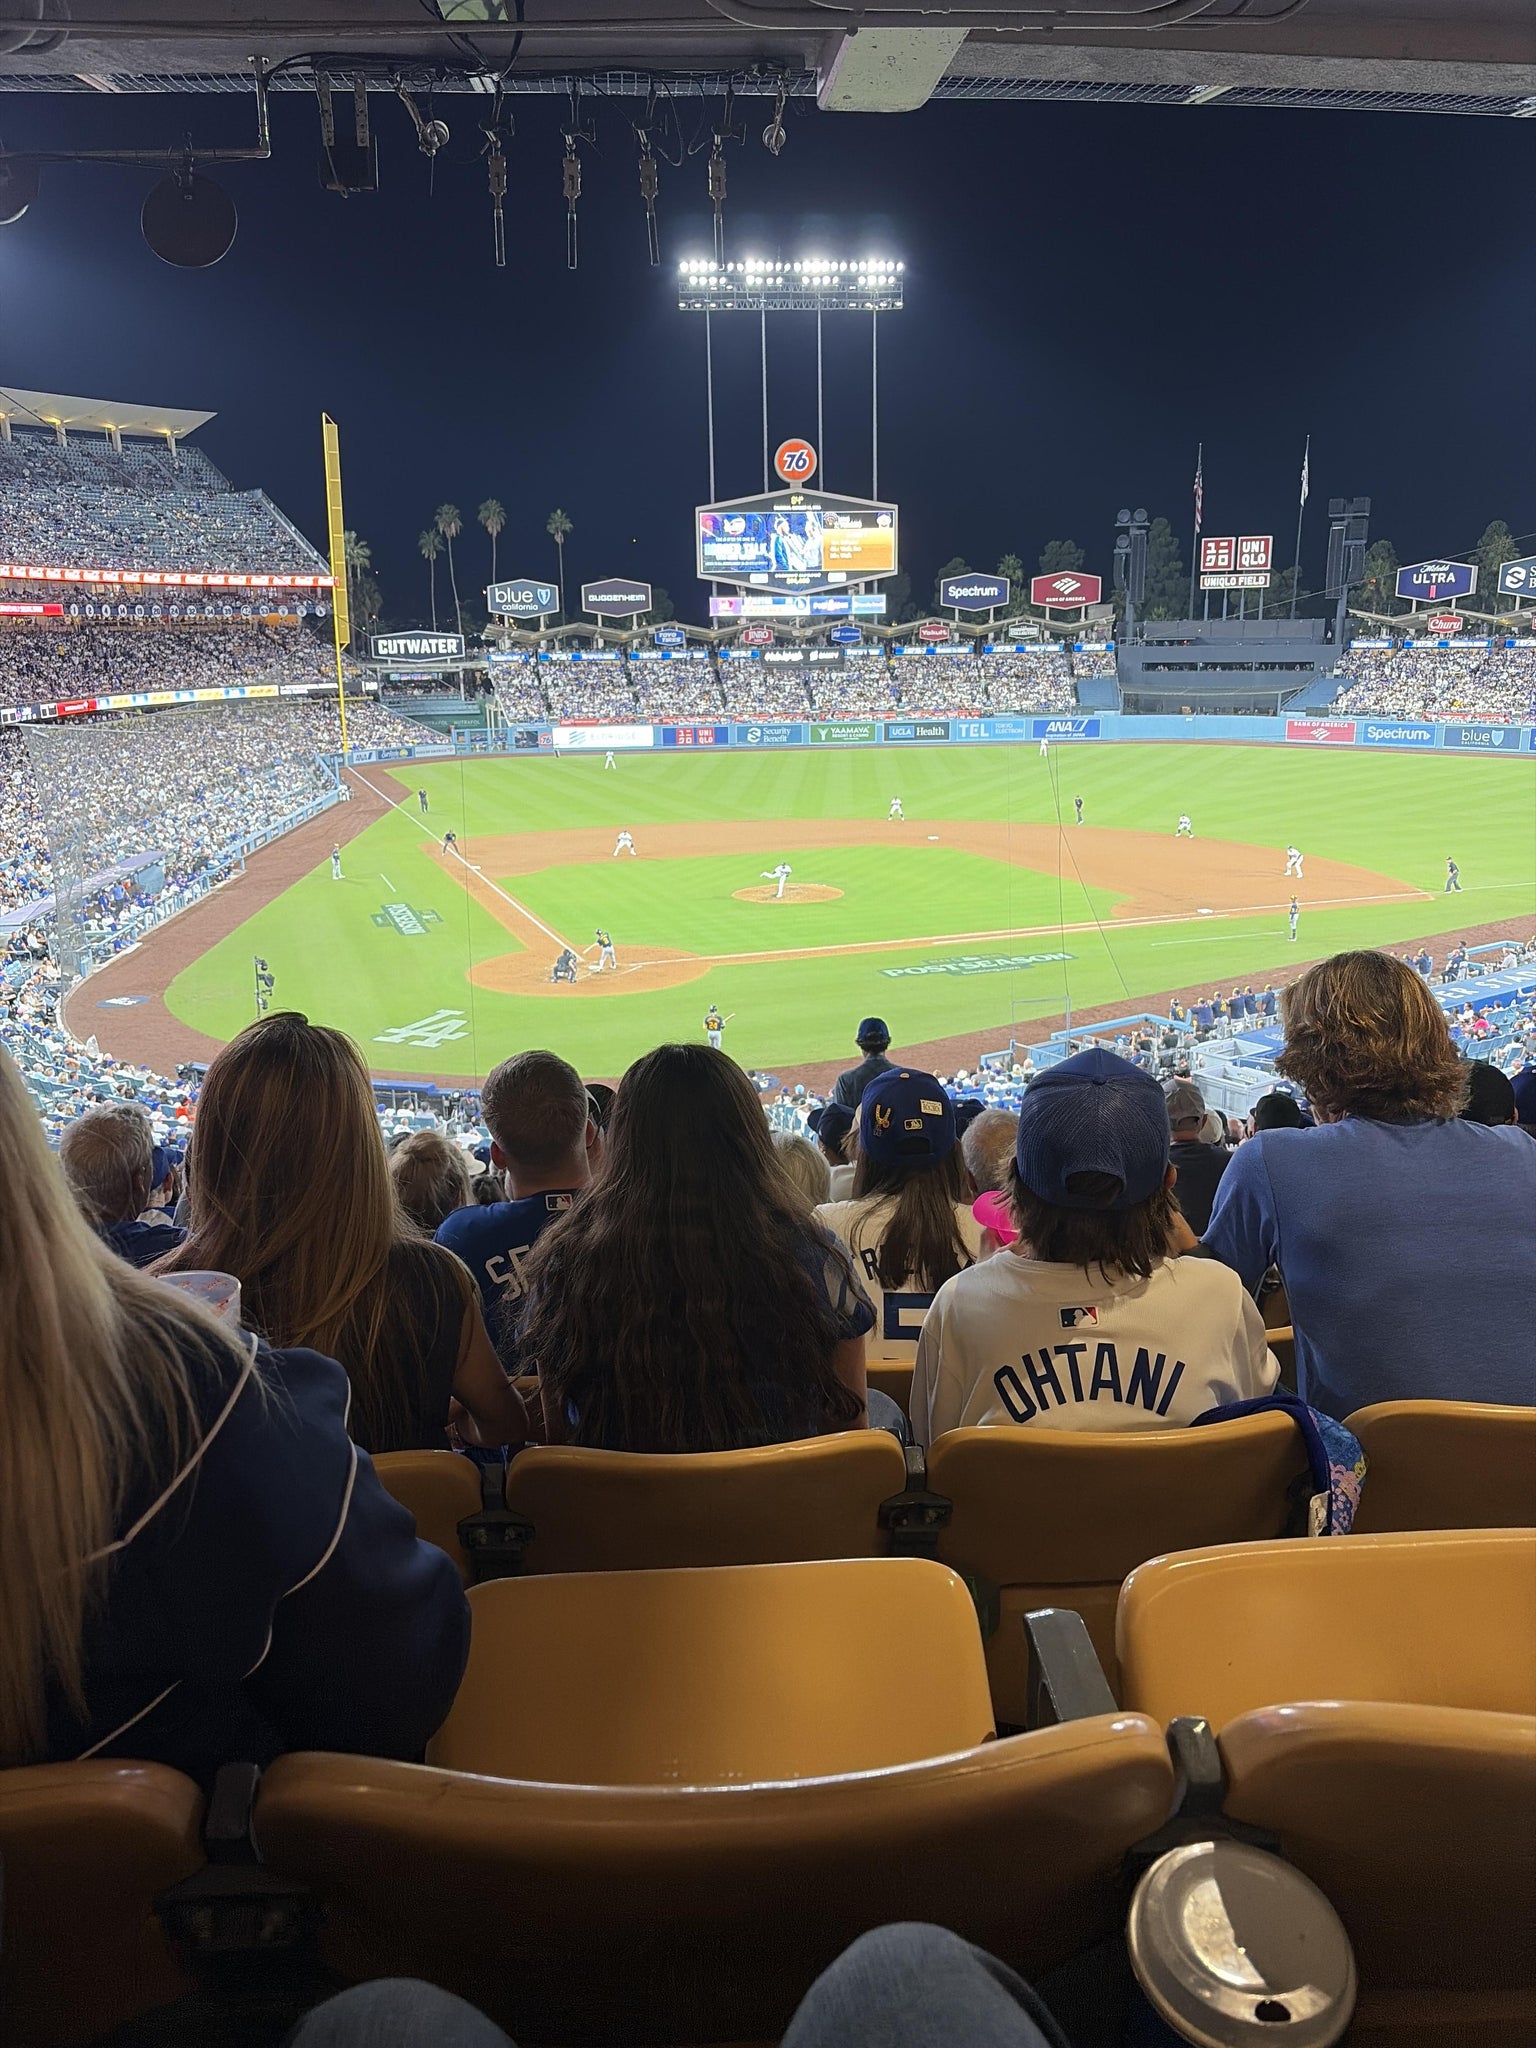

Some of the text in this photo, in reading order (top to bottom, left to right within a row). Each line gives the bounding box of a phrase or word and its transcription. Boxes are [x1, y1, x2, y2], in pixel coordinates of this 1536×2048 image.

[783, 449, 809, 472] 76
[1242, 540, 1265, 553] UNI
[1241, 553, 1266, 567] QLO
[1204, 575, 1265, 588] UNIQLO FIELD
[1412, 573, 1456, 584] ULTRA
[495, 587, 533, 603] blue
[588, 594, 646, 602] GUGGENHEIM
[948, 585, 998, 599] Spectrum
[502, 603, 538, 611] california
[1430, 619, 1460, 631] Churu
[749, 631, 769, 640] JINRO
[378, 638, 458, 655] CUTWATER
[763, 727, 790, 736] Security
[916, 727, 944, 736] Health
[958, 724, 989, 737] TEL
[1046, 721, 1073, 732] ANA
[541, 736, 551, 744] 76
[699, 736, 713, 744] QLO
[1367, 726, 1426, 741] Spectrum
[1461, 728, 1490, 742] blue
[883, 951, 1073, 978] POSTSEASON
[993, 1342, 1186, 1424] OHTANI
